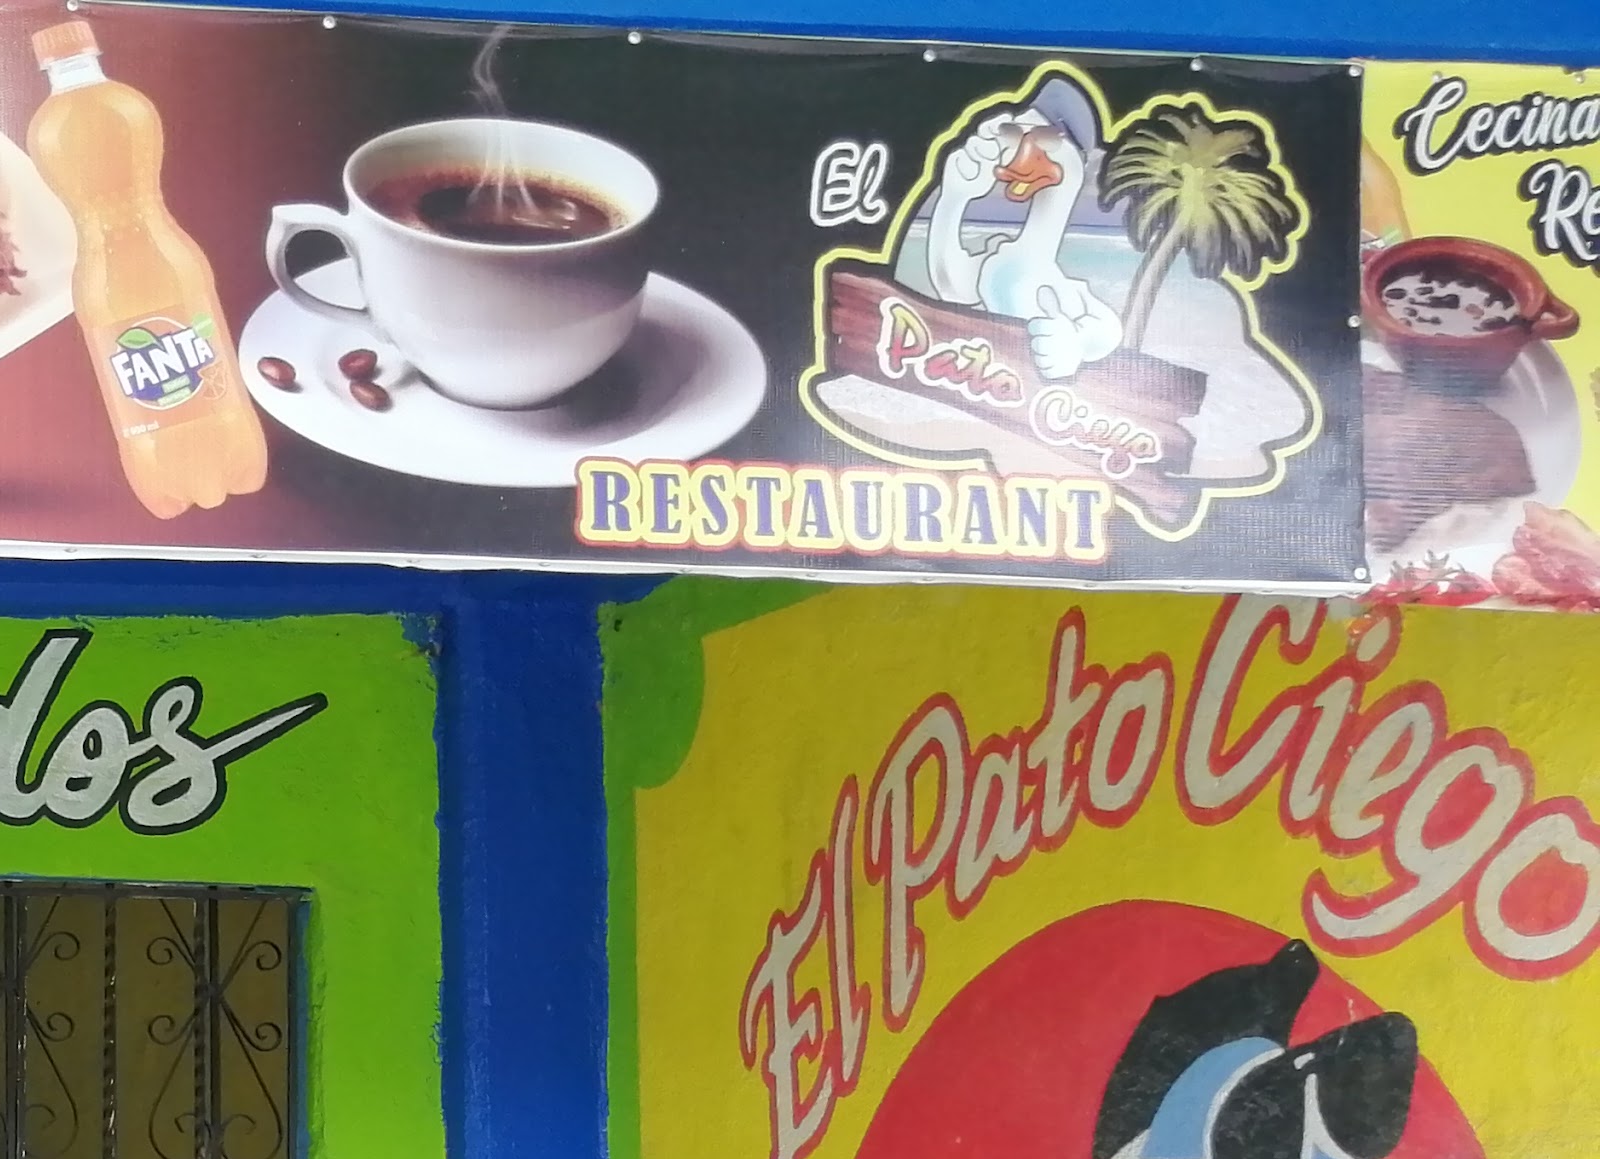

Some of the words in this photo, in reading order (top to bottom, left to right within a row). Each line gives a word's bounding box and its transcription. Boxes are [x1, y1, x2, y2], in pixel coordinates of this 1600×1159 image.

[810, 141, 889, 227] El
[111, 328, 214, 396] FANTA
[878, 299, 1026, 407] Pato
[1029, 385, 1162, 479] Ciego
[578, 459, 1109, 560] RESTAURANT
[865, 606, 1176, 1032] Pato
[1176, 593, 1600, 980] Ciego
